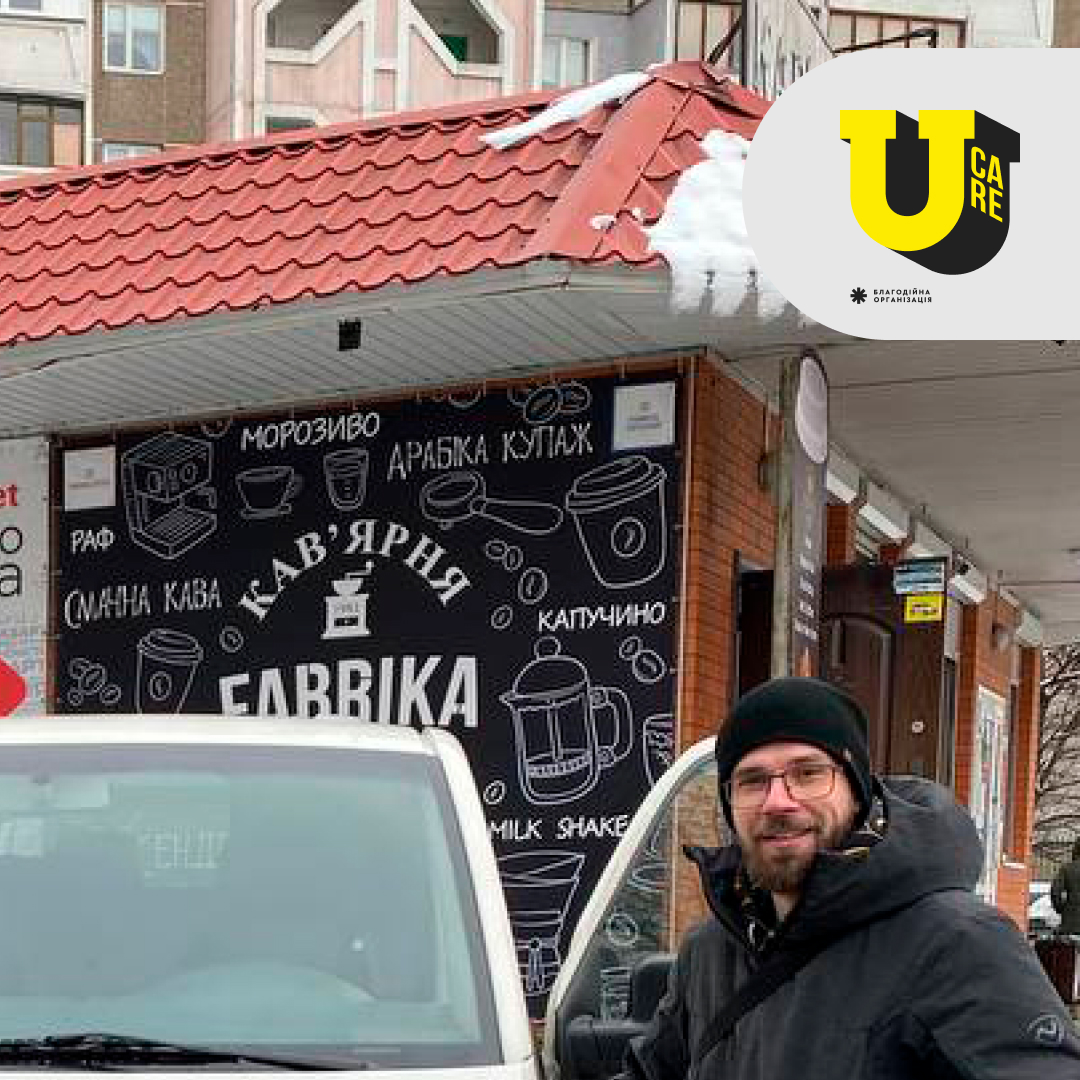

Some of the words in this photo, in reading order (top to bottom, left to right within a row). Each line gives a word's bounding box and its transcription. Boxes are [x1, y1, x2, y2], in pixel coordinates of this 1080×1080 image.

[241, 412, 380, 450] МОРОЗИВО
[502, 422, 593, 463] КУПАЖ
[72, 526, 115, 554] РАФ
[163, 577, 223, 614] КАВА
[537, 601, 666, 633] КАПУЧИНО
[489, 819, 543, 841] MILK
[556, 814, 629, 840] SHAKE
